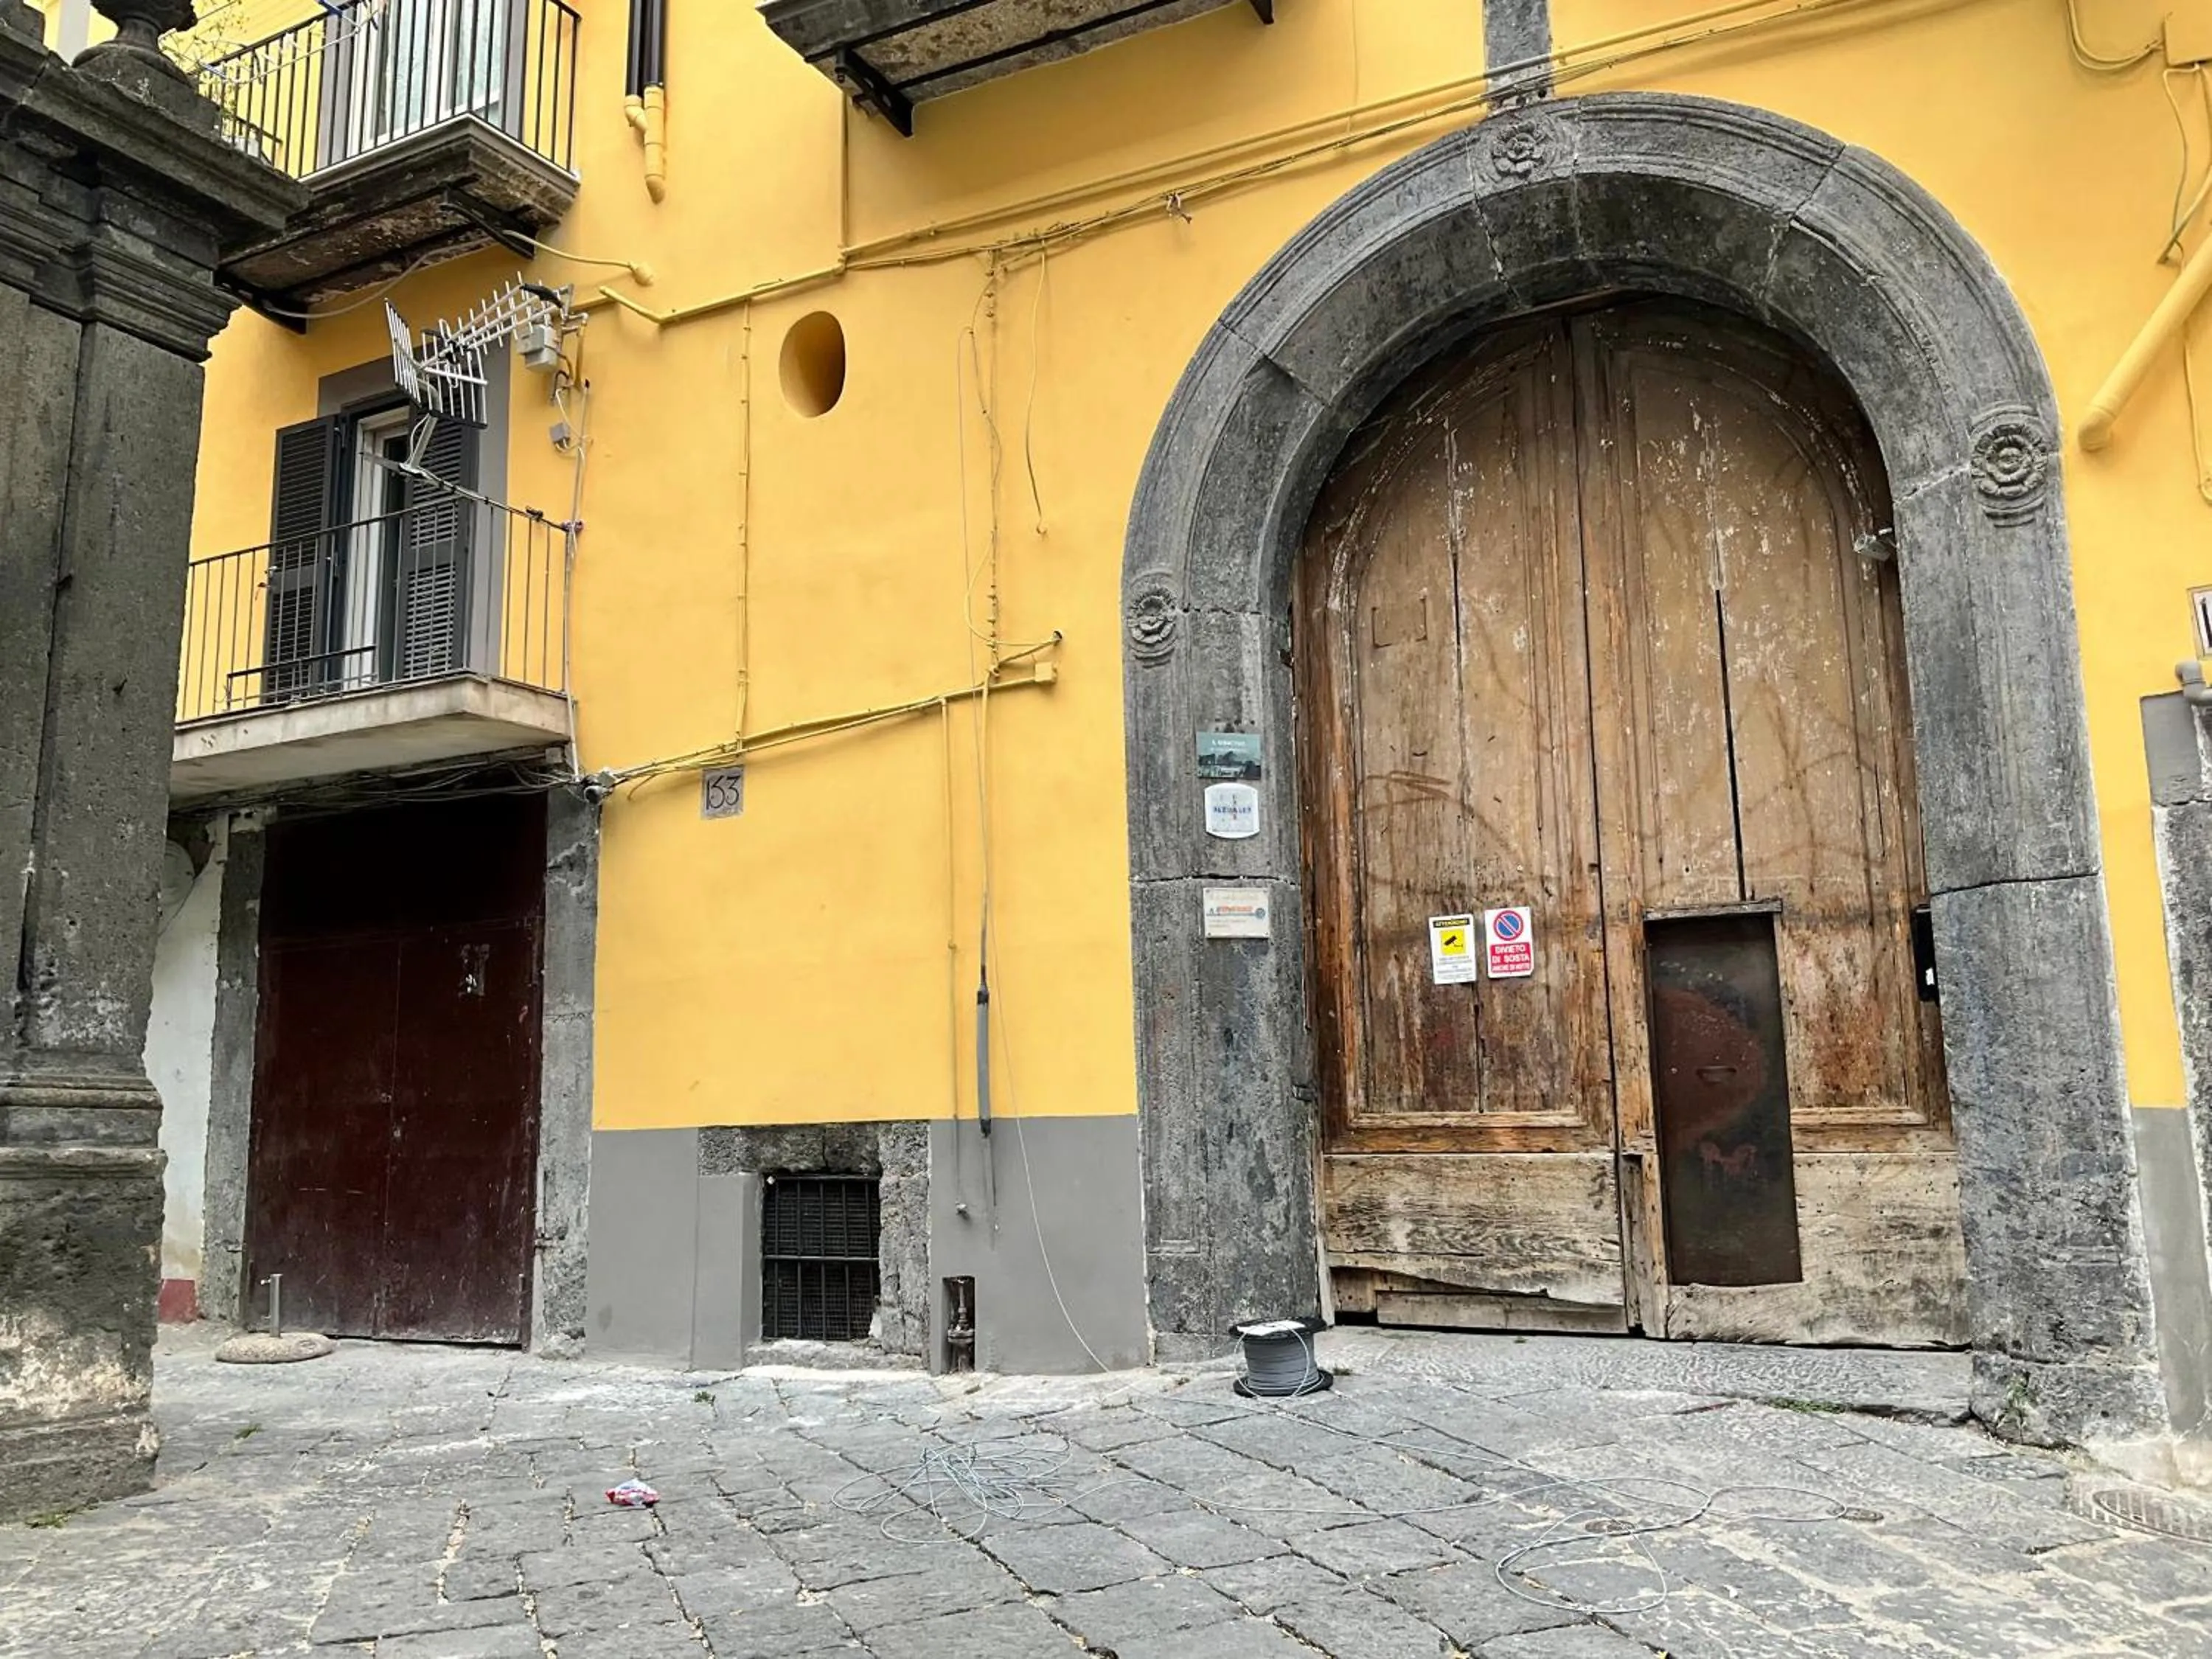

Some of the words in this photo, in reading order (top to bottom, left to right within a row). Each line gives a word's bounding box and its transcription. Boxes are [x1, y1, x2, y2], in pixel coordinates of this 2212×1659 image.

[1495, 944, 1526, 954] DIVIETO
[1492, 955, 1501, 964] DI
[1503, 953, 1530, 963] SOSTA
